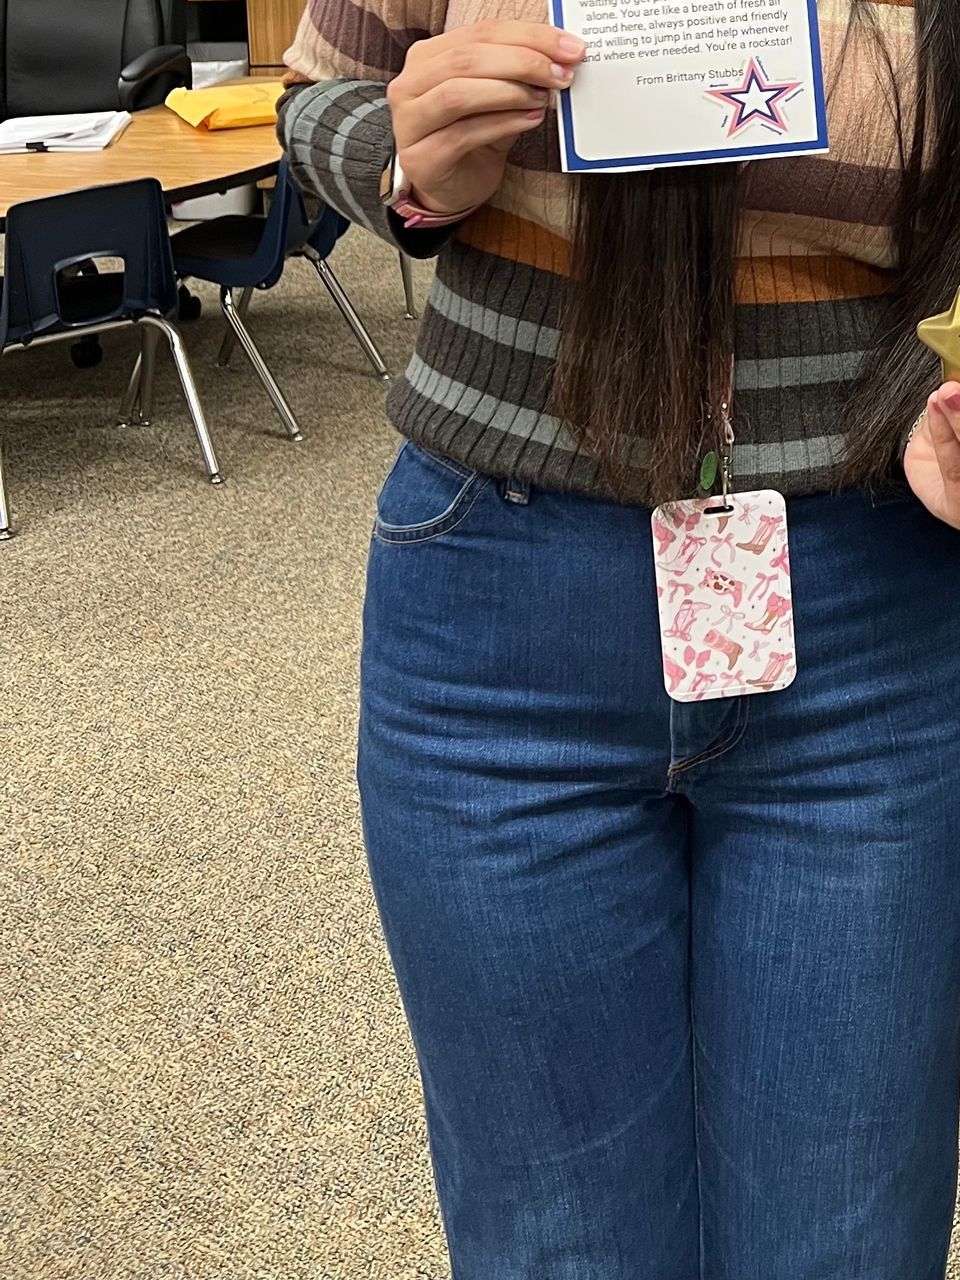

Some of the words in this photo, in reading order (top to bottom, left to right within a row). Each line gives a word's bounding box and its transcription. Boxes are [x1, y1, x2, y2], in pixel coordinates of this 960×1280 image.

[582, 24, 618, 35] around
[620, 22, 647, 32] here,
[648, 18, 684, 30] always
[687, 15, 727, 28] positive
[729, 13, 748, 23] and
[751, 10, 788, 21] friendly
[586, 11, 618, 22] alone.
[620, 8, 640, 18] You
[643, 7, 660, 17] are
[662, 5, 680, 15] like
[682, 5, 689, 13] a
[691, 1, 724, 13] breath
[727, 0, 737, 9] of
[605, 36, 639, 47] willing
[641, 35, 652, 44] to
[654, 33, 681, 45] jump
[683, 31, 692, 41] in
[695, 29, 714, 39] and
[716, 27, 738, 38] help
[741, 24, 789, 35] whenever
[582, 52, 601, 63] and
[604, 50, 635, 61] where
[638, 49, 660, 58] ever
[662, 44, 703, 56] needed.
[706, 41, 737, 52] You're
[740, 42, 746, 50] a
[748, 36, 793, 48] rockstar!
[636, 75, 664, 85] From
[666, 71, 706, 83] Brittany
[708, 68, 744, 79] Stubbs
